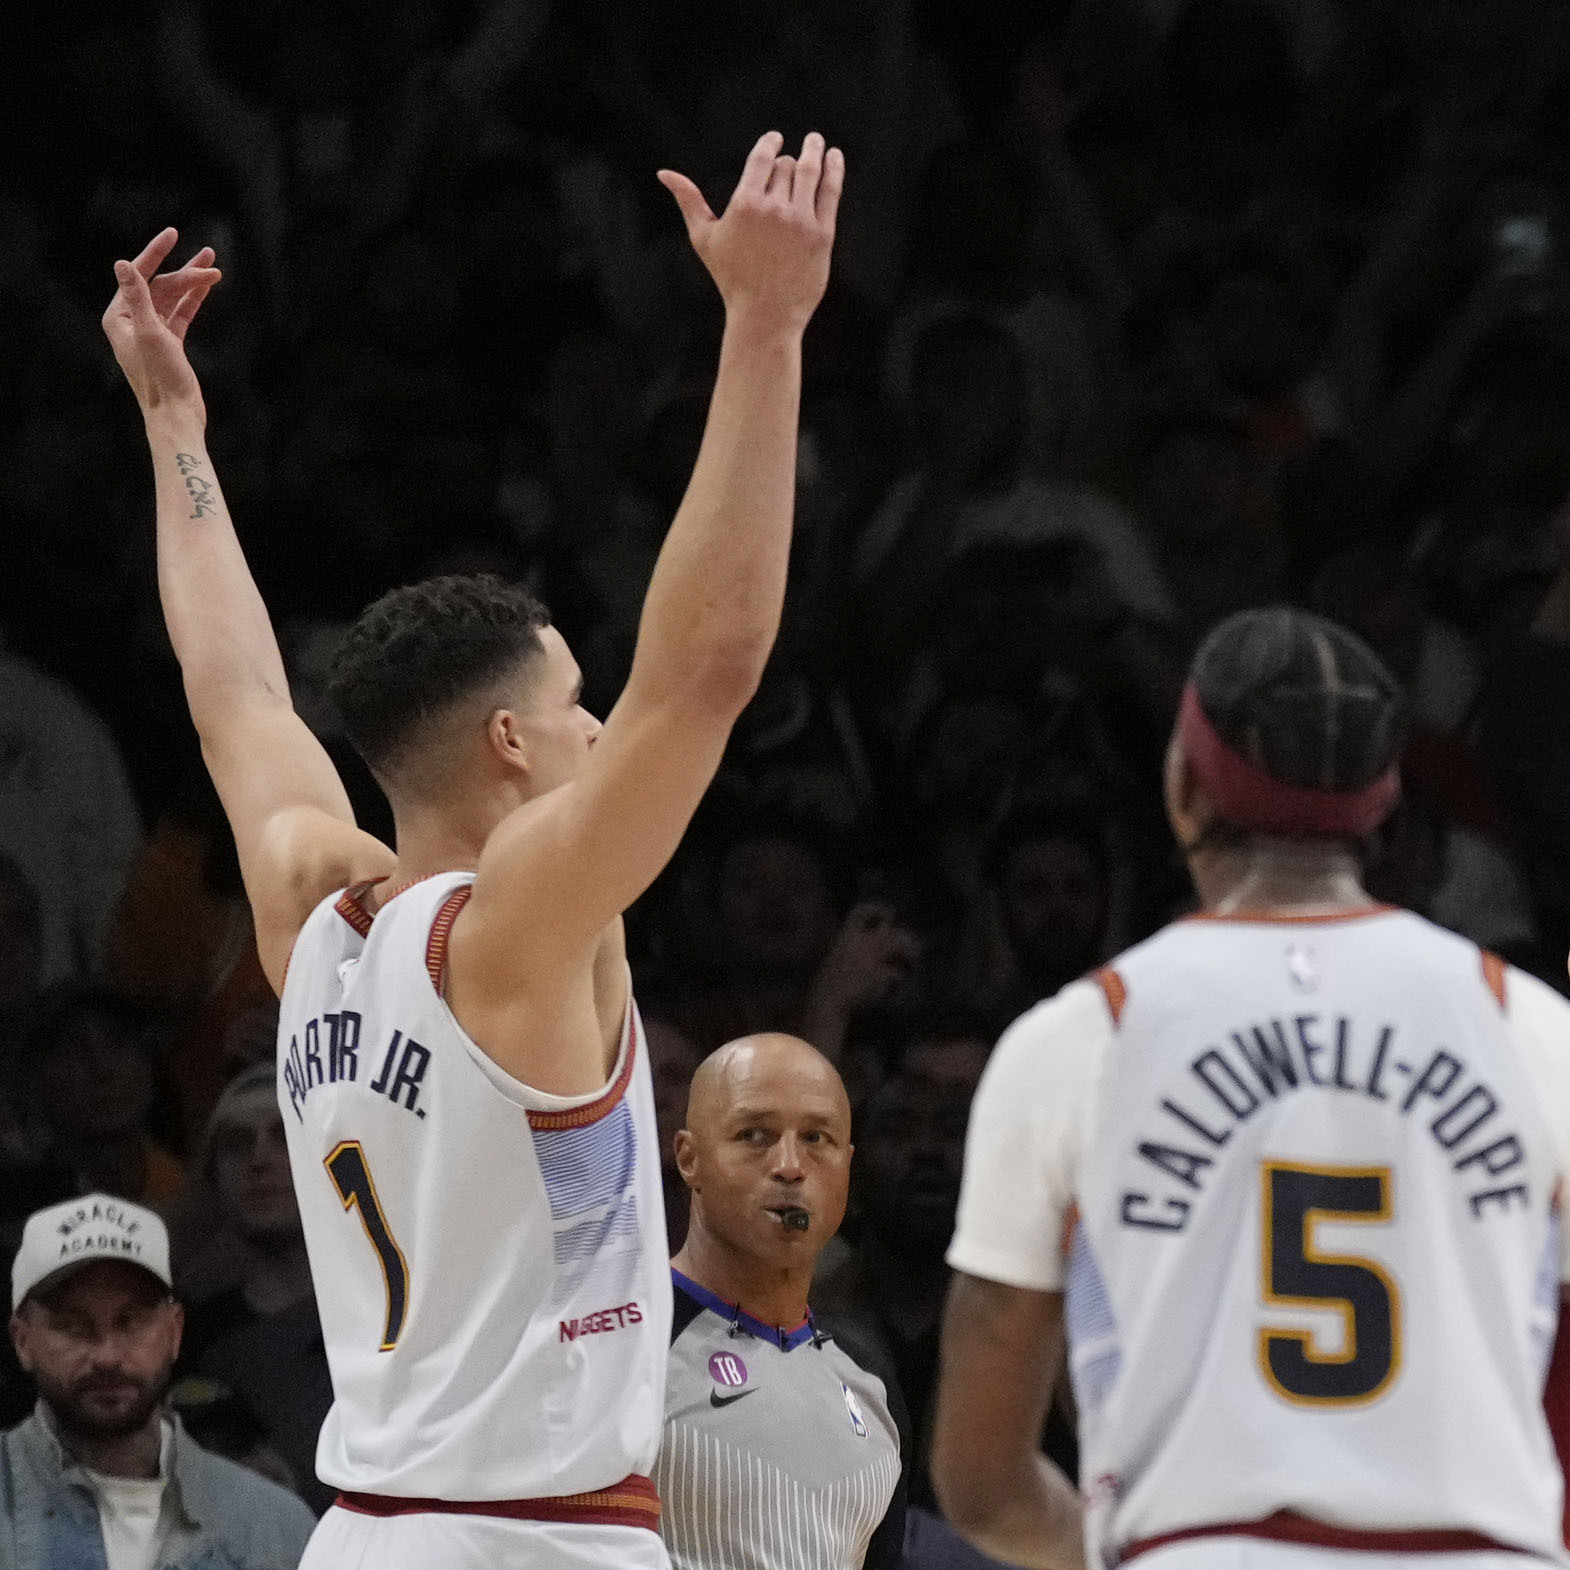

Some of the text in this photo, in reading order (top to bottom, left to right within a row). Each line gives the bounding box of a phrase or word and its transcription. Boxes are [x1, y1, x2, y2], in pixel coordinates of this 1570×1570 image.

[370, 1029, 431, 1121] JR.
[1121, 1013, 1528, 1234] CALDWELL-POPE
[59, 1233, 142, 1259] ACADEMY
[322, 1140, 410, 1353] 1
[1257, 1158, 1402, 1408] 5
[559, 1302, 643, 1343] NGGETS
[714, 1356, 743, 1386] TB
